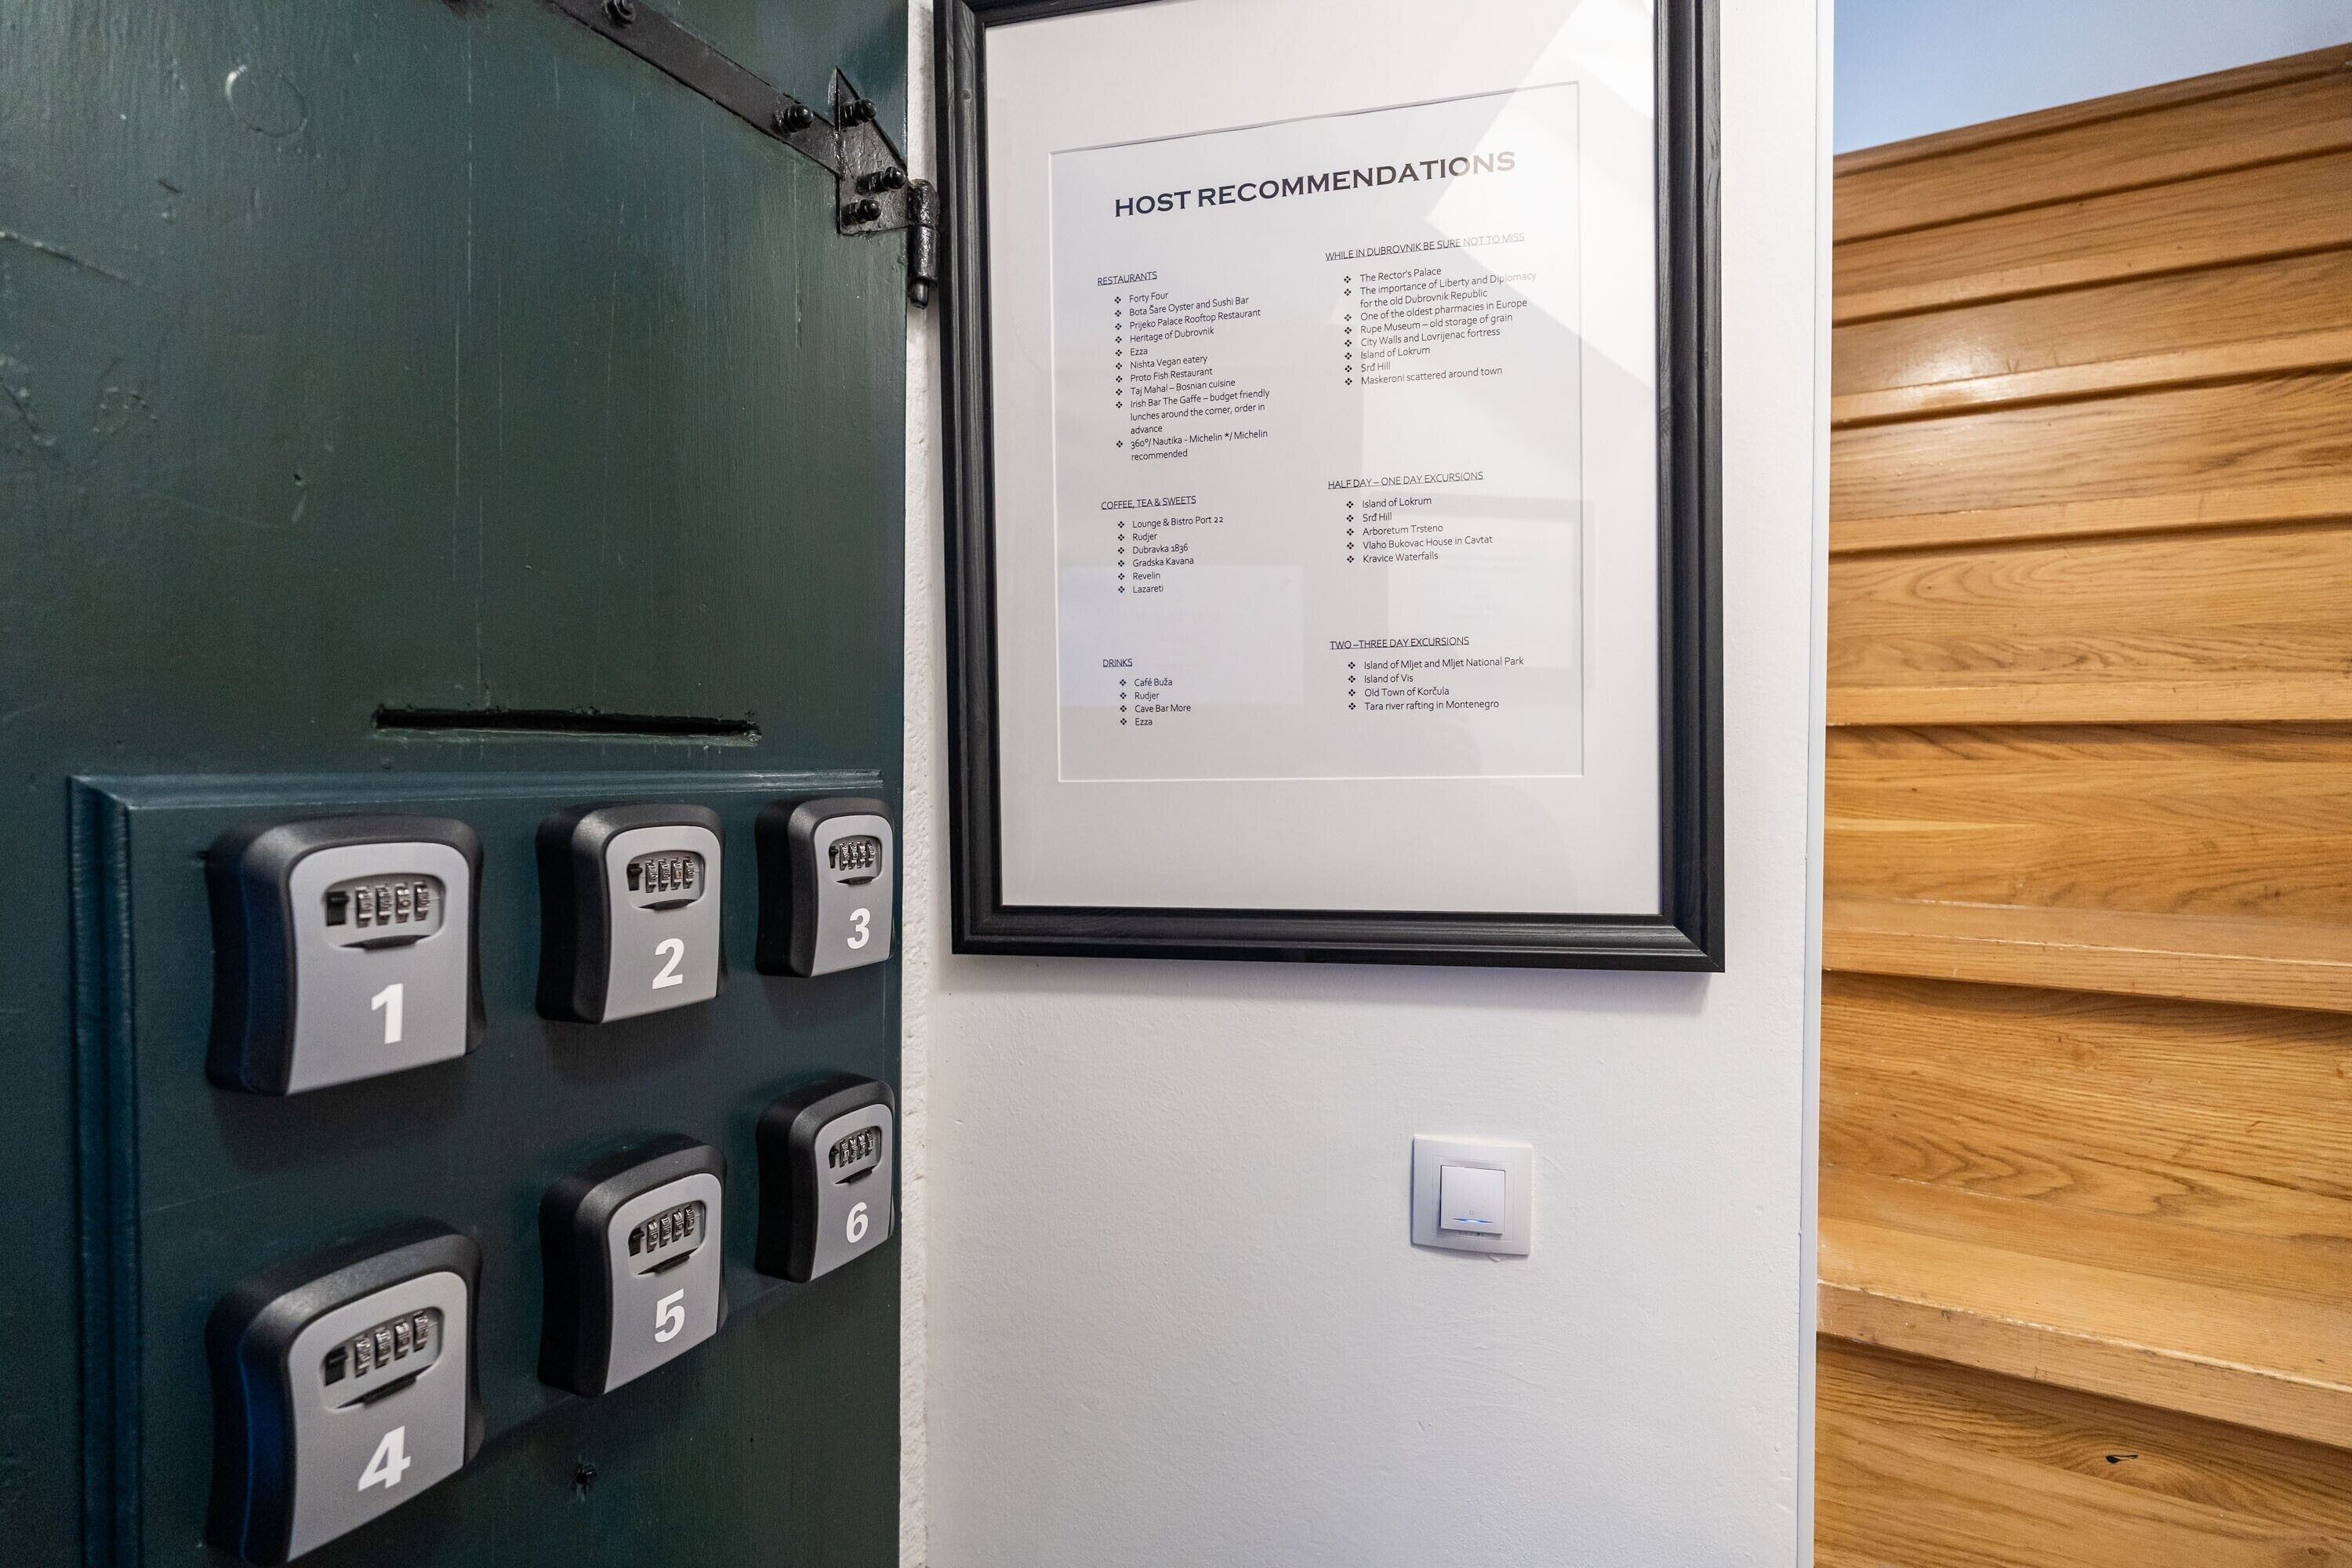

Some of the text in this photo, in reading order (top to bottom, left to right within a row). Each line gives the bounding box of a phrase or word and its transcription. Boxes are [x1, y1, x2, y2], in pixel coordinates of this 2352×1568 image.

[1115, 151, 1516, 217] HOST RECOMMENDATIONS
[1325, 233, 1524, 261] WHILE IN DUBROVNIK BE SURE NOT TO MISS
[1098, 271, 1157, 286] RESTAURANTS
[1360, 274, 1376, 282] The
[1414, 267, 1442, 278] Palace
[1360, 272, 1537, 296] The importance of Liberty and Diplomacy
[1129, 292, 1168, 303] Forty Four
[1360, 289, 1487, 308] for the old Dubrovnik Republic
[1130, 307, 1147, 317] Bota
[1149, 305, 1167, 314] Šare
[1169, 302, 1194, 313] Oyster
[1212, 297, 1233, 307] Sushi
[1236, 296, 1249, 305] Bar
[1361, 311, 1377, 321] One
[1380, 310, 1389, 318] of
[1391, 308, 1405, 318] the
[1406, 307, 1432, 317] oldest
[1435, 303, 1484, 316] pharmacies
[1497, 299, 1527, 310] Europe
[1130, 310, 1261, 331] Prijeko Palace Rooftop Restaurant
[1131, 327, 1214, 343] Heritage of Dubrovnik
[1361, 328, 1500, 347] City Walls and Lovrijenac fortress
[1361, 347, 1430, 360] Island of Lokrum
[1131, 355, 1207, 369] Nishta Vegan eatery
[1361, 361, 1390, 372] Srđ Hill
[1154, 372, 1168, 380] Fish
[1171, 368, 1212, 379] Restaurant
[1361, 367, 1502, 385] Maskeroni scattered around town
[1131, 412, 1160, 421] lunches
[1162, 409, 1189, 419] around
[1191, 408, 1203, 416] the
[1205, 405, 1232, 416] corner,
[1235, 405, 1256, 413] order
[1131, 425, 1163, 435] advance
[1131, 449, 1188, 461] recommended
[1328, 480, 1351, 489] HALF
[1353, 479, 1372, 488] DAY
[1381, 477, 1401, 485] ONE
[1403, 475, 1422, 485] DAY
[1425, 471, 1483, 483] EXCURSIONS
[1102, 500, 1134, 510] COFFEE,
[1155, 498, 1160, 506] &
[1163, 495, 1196, 505] SWEETS
[1363, 499, 1386, 509] Island
[1399, 497, 1432, 506] Lokrum
[1133, 519, 1161, 529] Lounge
[1363, 512, 1392, 522] Srđ Hill
[1363, 524, 1443, 535] Arboretum Trsteno
[1133, 532, 1157, 543] Rudjer
[1363, 540, 1387, 550] Vlaho
[1389, 539, 1424, 548] Bukovac
[1426, 538, 1453, 546] House
[1465, 535, 1493, 544] Cavtat
[1171, 544, 1189, 553] 1836
[1133, 559, 1163, 568] Gradska
[1363, 552, 1438, 563] Kravice Waterfalls
[1330, 641, 1352, 650] TWO
[1410, 637, 1469, 647] EXCURSIONS
[1103, 659, 1132, 667] DRINKS
[1364, 657, 1524, 670] Island of Mljet and Mljet National Park
[1154, 677, 1172, 686] Buža
[1364, 674, 1388, 683] Island
[1134, 692, 1160, 701] Rudjer
[1381, 688, 1405, 696] Town
[1407, 687, 1416, 695] of
[1417, 687, 1449, 695] Korčula
[1364, 702, 1383, 710] Tara
[1406, 700, 1434, 711] rafting
[1436, 699, 1443, 709] in
[1446, 699, 1499, 709] Montenegro
[847, 908, 871, 949] 3
[652, 938, 684, 989] 2
[371, 982, 405, 1044] 1
[845, 1202, 869, 1245] 6
[654, 1289, 684, 1344] 5
[358, 1425, 410, 1492] 4
